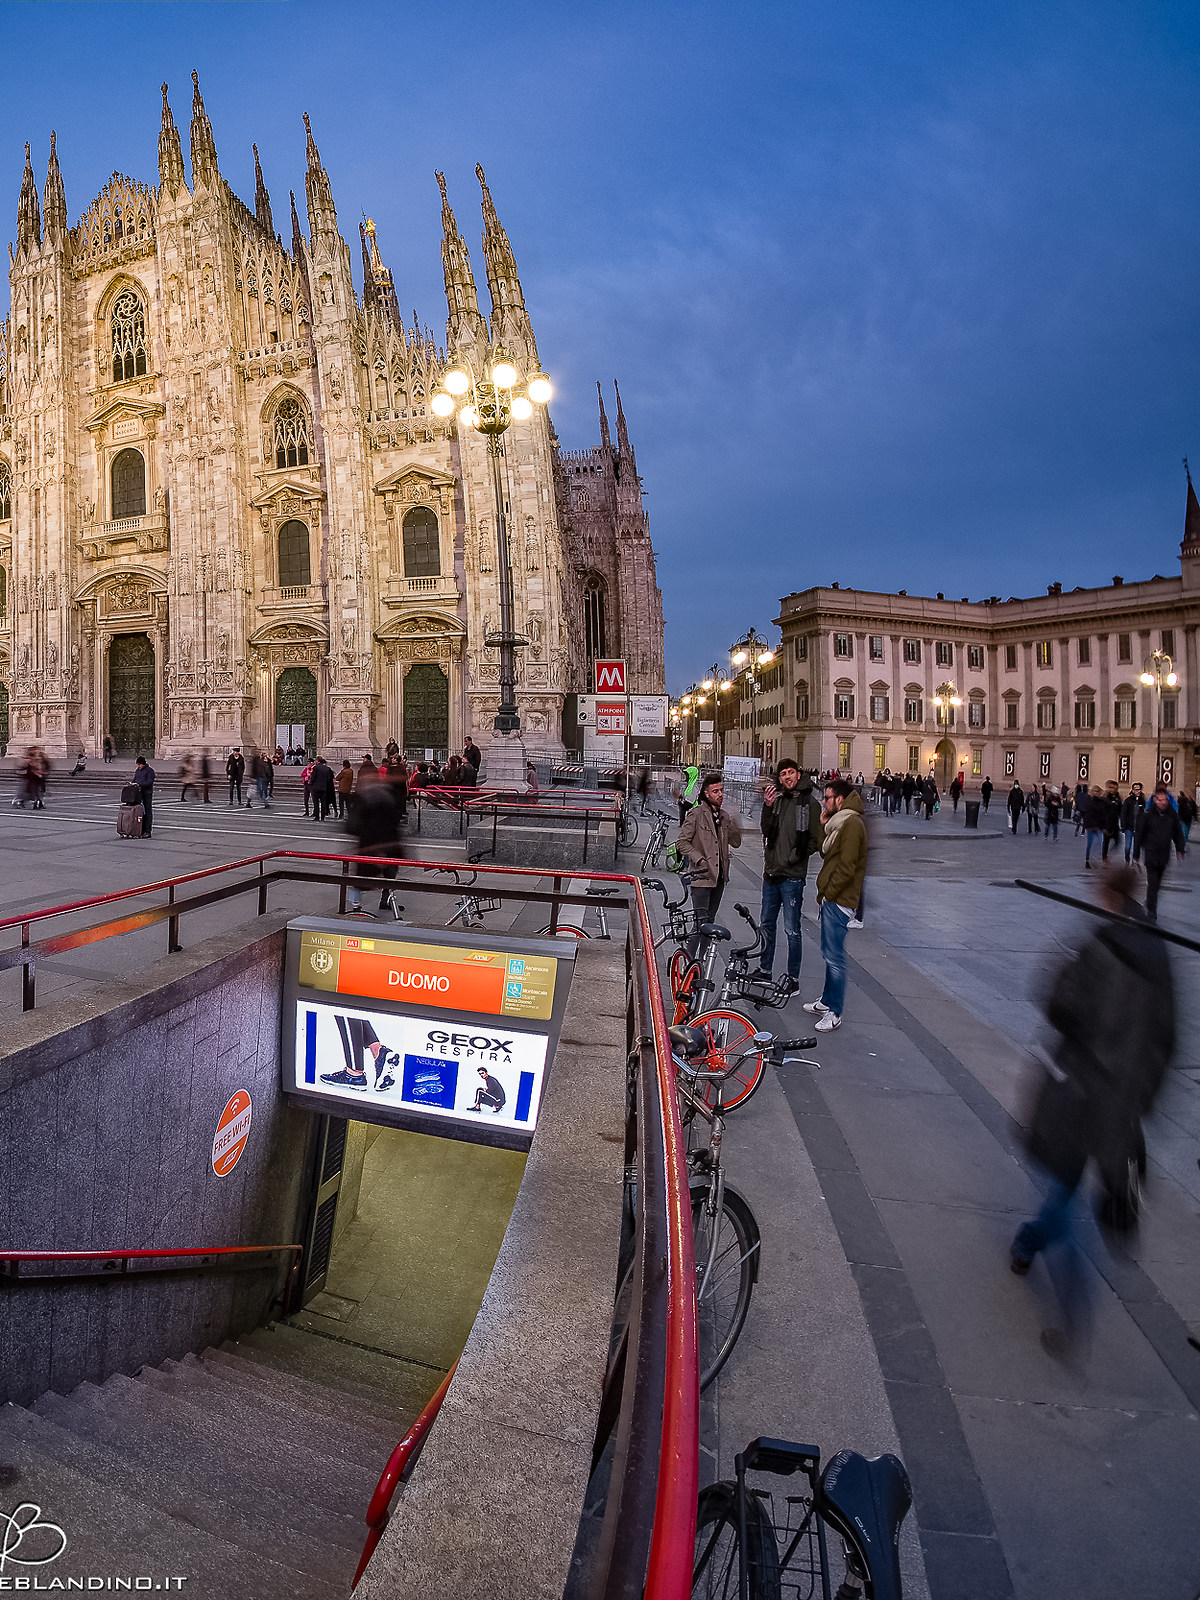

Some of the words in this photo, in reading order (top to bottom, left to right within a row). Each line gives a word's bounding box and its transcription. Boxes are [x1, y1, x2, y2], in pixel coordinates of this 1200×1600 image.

[598, 667, 623, 687] M
[311, 937, 335, 946] Milano
[473, 953, 489, 961] ATM
[388, 970, 450, 992] DUOMO
[425, 1042, 512, 1063] RESPIRA
[427, 1030, 514, 1054] GEOX
[214, 1130, 232, 1155] FREE
[232, 1113, 250, 1138] WI-FI
